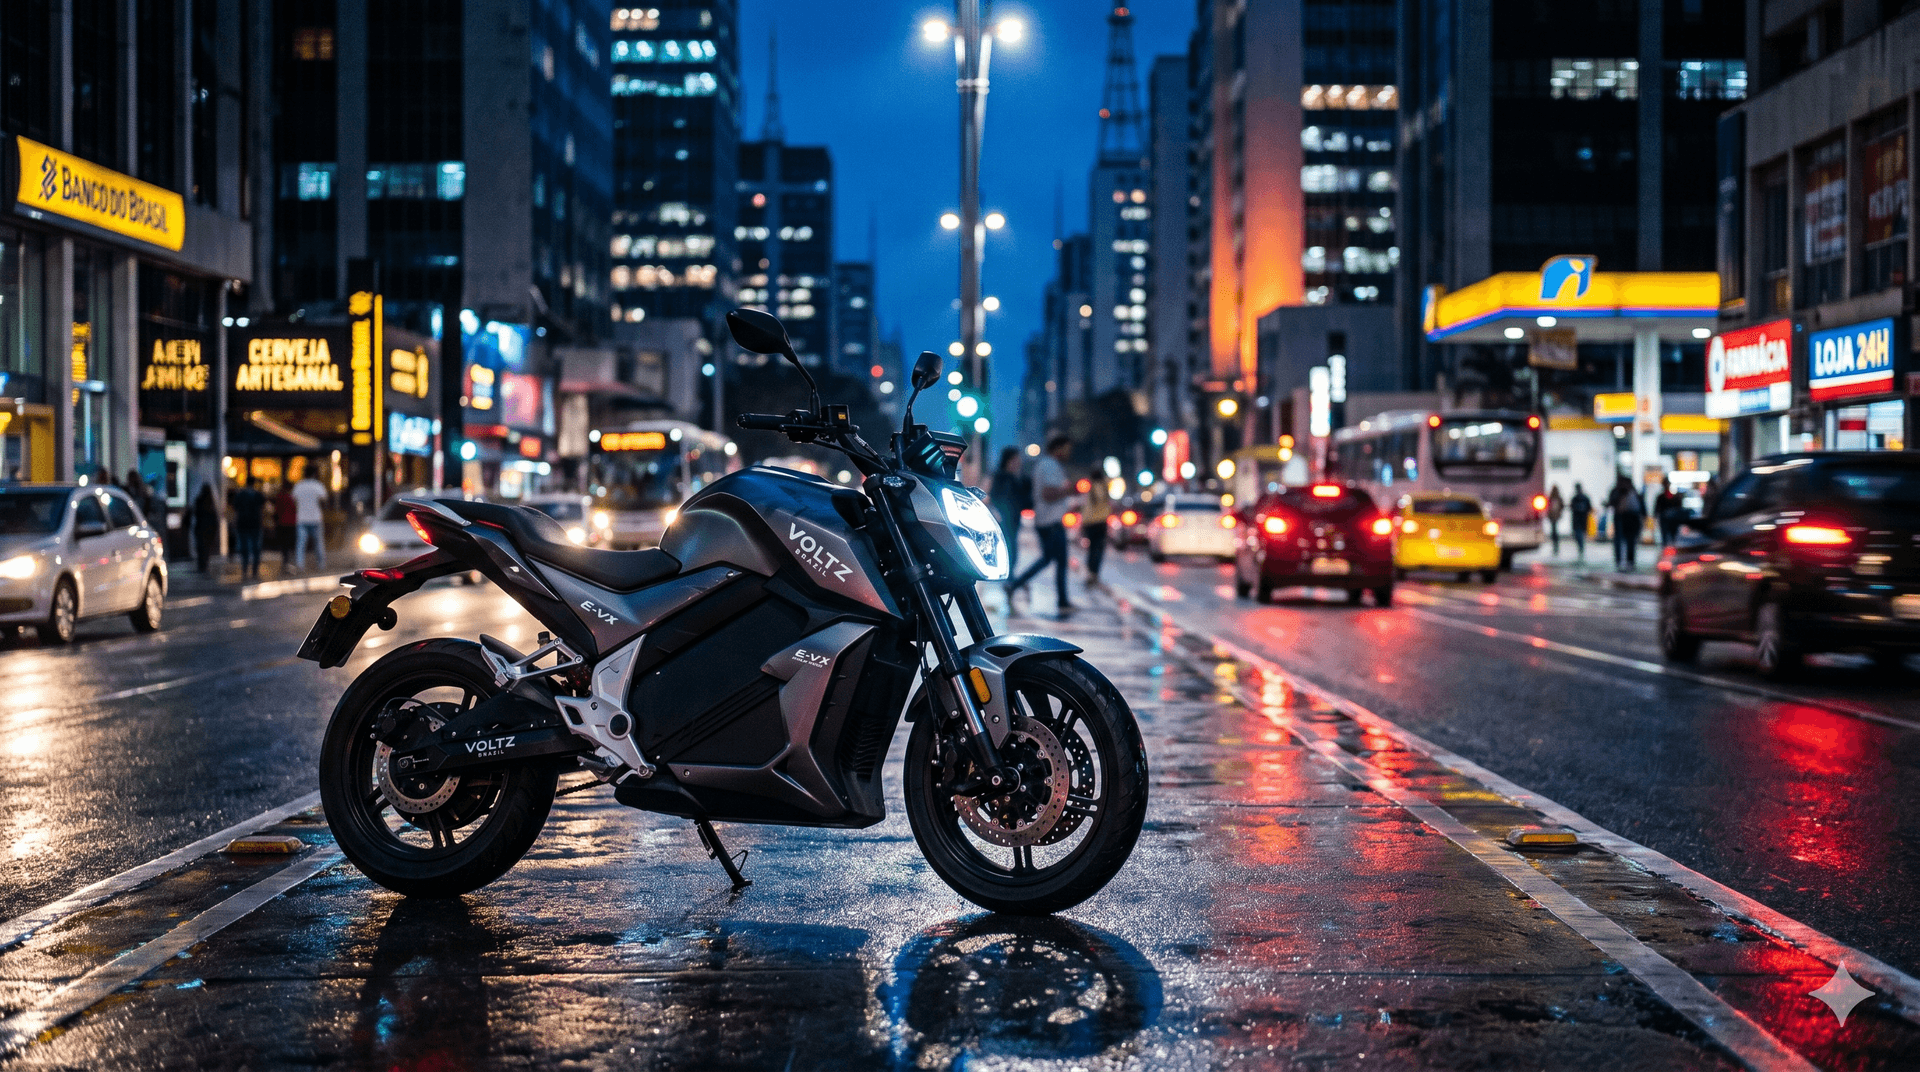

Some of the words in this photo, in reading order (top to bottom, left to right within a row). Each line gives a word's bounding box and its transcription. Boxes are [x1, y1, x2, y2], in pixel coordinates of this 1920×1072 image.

[62, 165, 108, 213] BANCO
[110, 186, 127, 220] DO
[129, 189, 169, 234] BRASIL
[248, 338, 331, 364] CERVEJA
[1815, 335, 1855, 377] LOJA
[1856, 327, 1890, 370] 24H
[236, 363, 344, 391] ARTESANAL
[789, 522, 853, 582] VOLTZ
[795, 548, 827, 577] BRAZIL
[580, 600, 619, 625] E-VX
[794, 649, 830, 665] E-VX
[465, 736, 516, 753] VOLTZ
